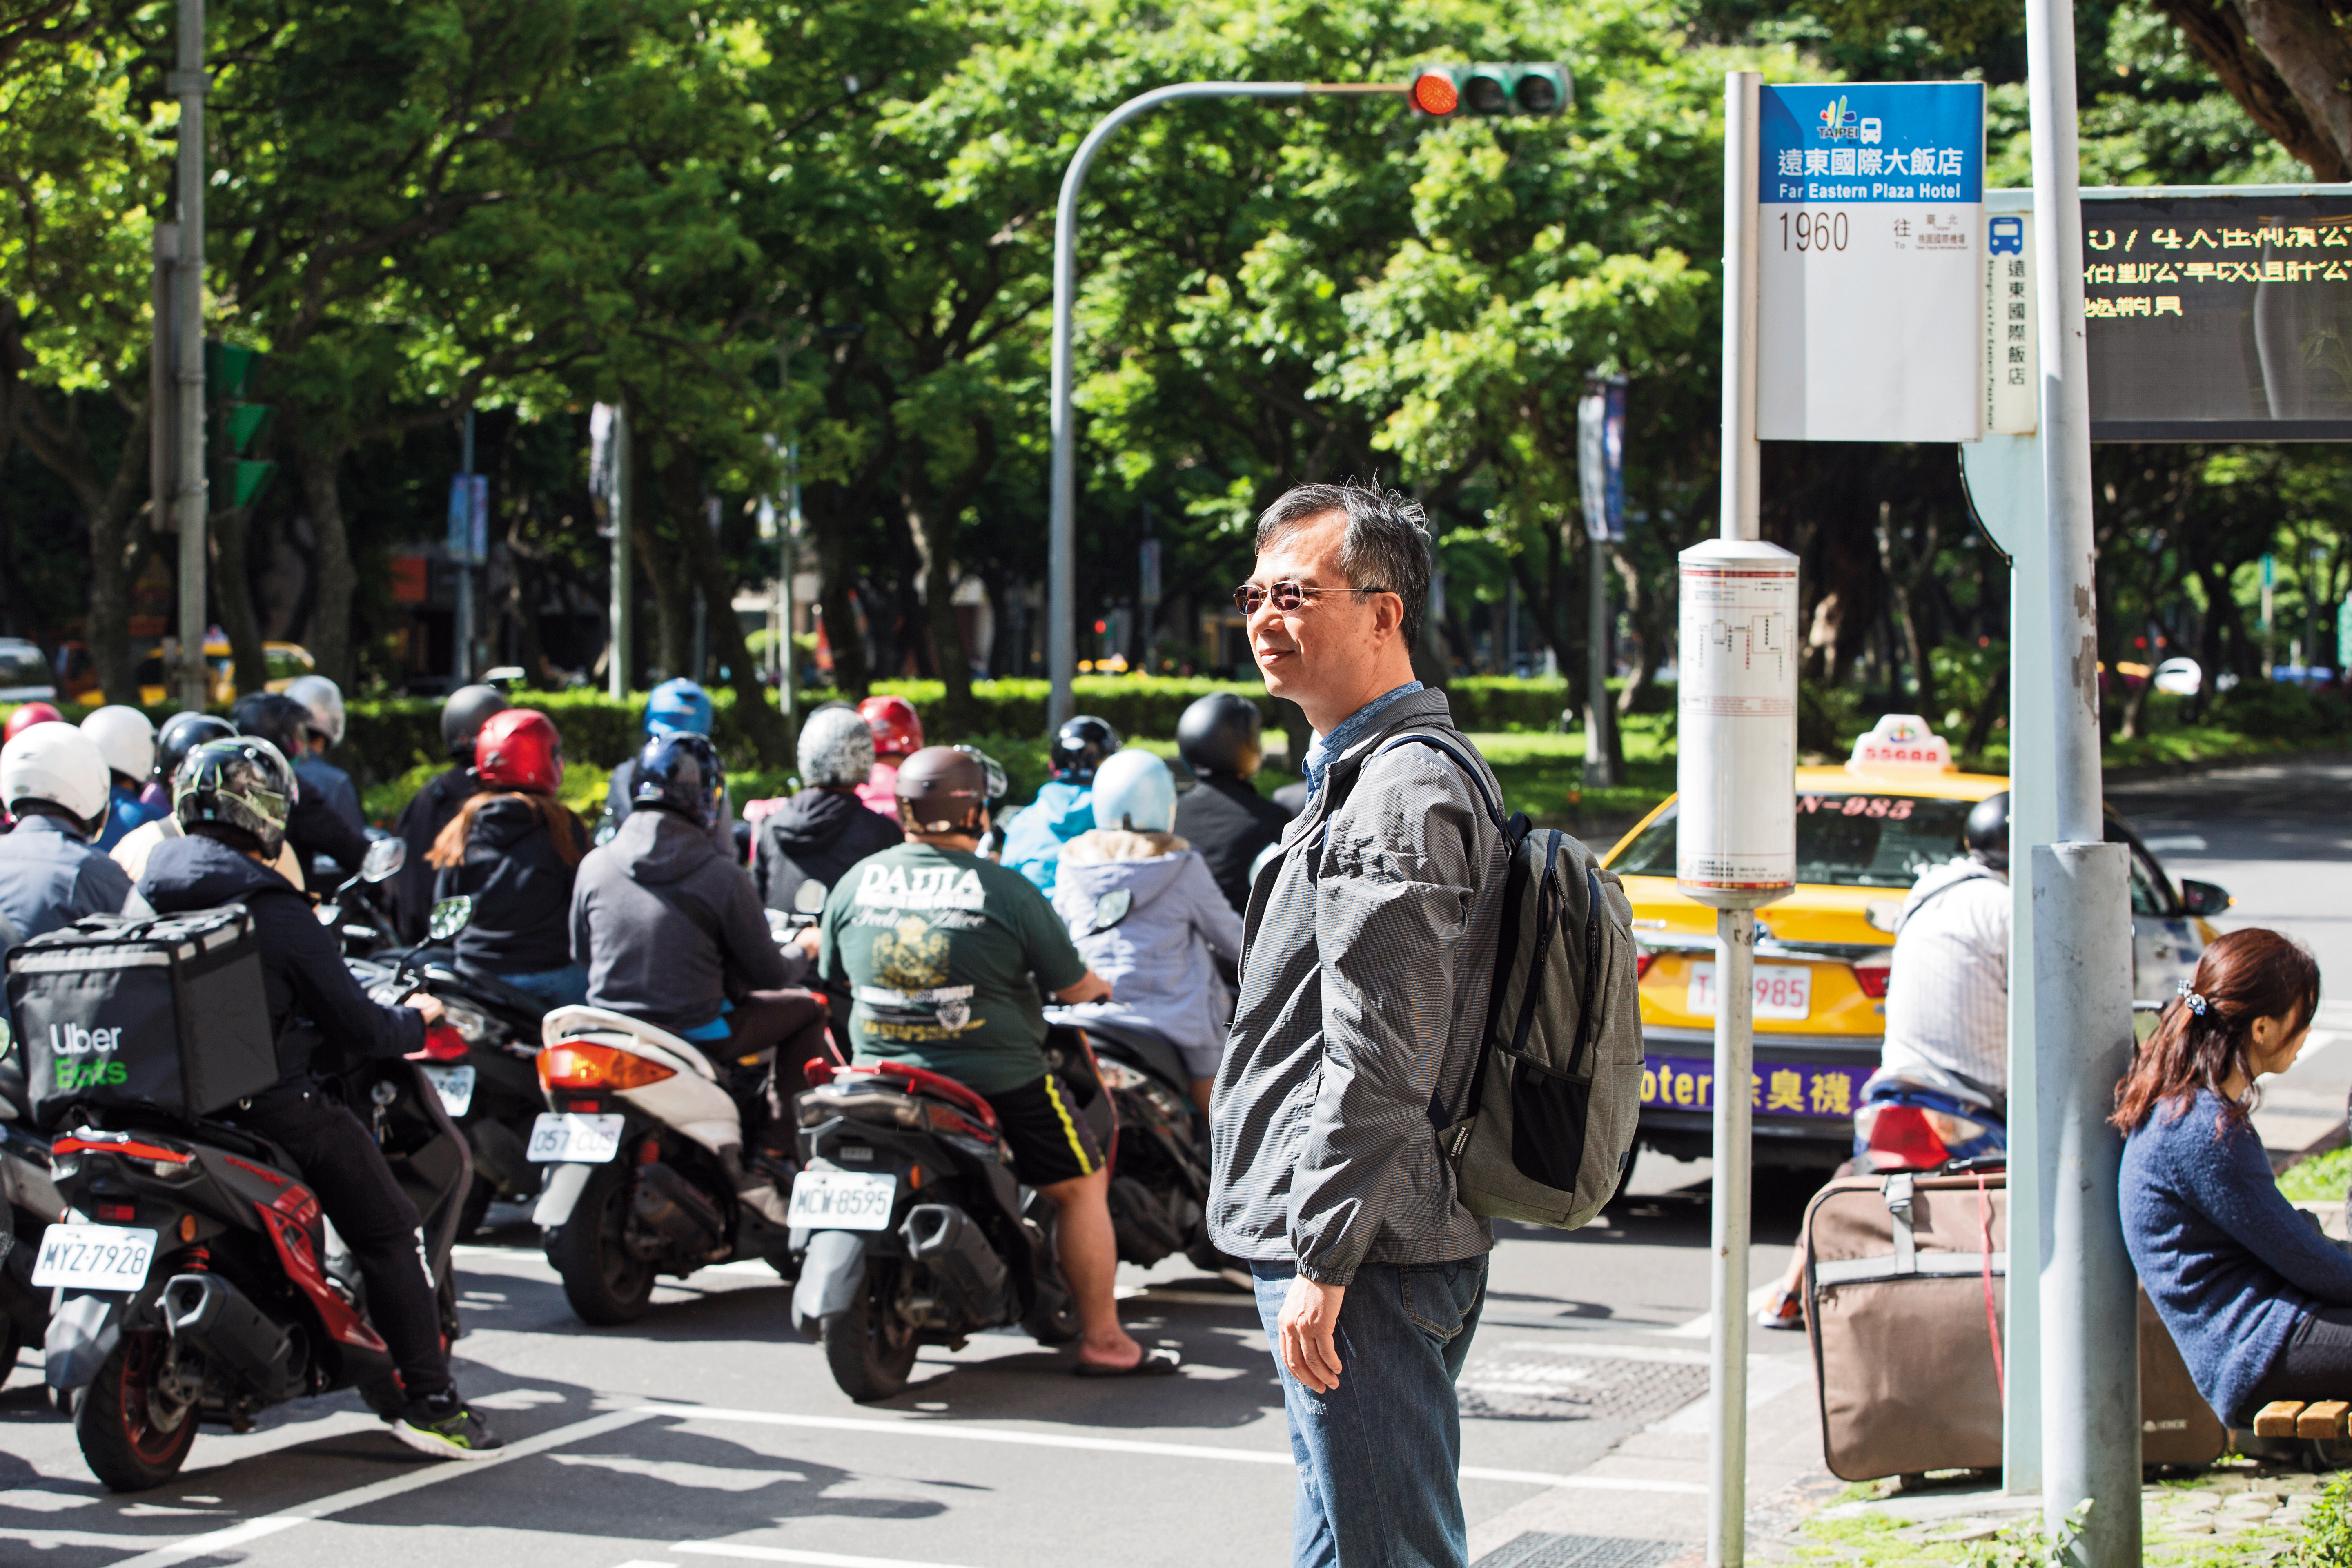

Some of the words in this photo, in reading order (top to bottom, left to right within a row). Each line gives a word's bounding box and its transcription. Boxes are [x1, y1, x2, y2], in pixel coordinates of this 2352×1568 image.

[1818, 127, 1858, 138] TAIPEI
[1777, 147, 1964, 176] 遠東國際大飯店
[1779, 183, 1804, 198] Far
[1809, 183, 1867, 198] Eastern
[1873, 183, 1914, 198] Plaza
[1919, 183, 1960, 198] Hotel
[1780, 212, 1848, 252] 1960
[1893, 218, 1911, 237] 往
[2008, 260, 2026, 385] 遠東國際飯店
[49, 1022, 122, 1055] Uber
[55, 1057, 128, 1089] Eats
[1452, 1130, 1465, 1154] PARKSIDE
